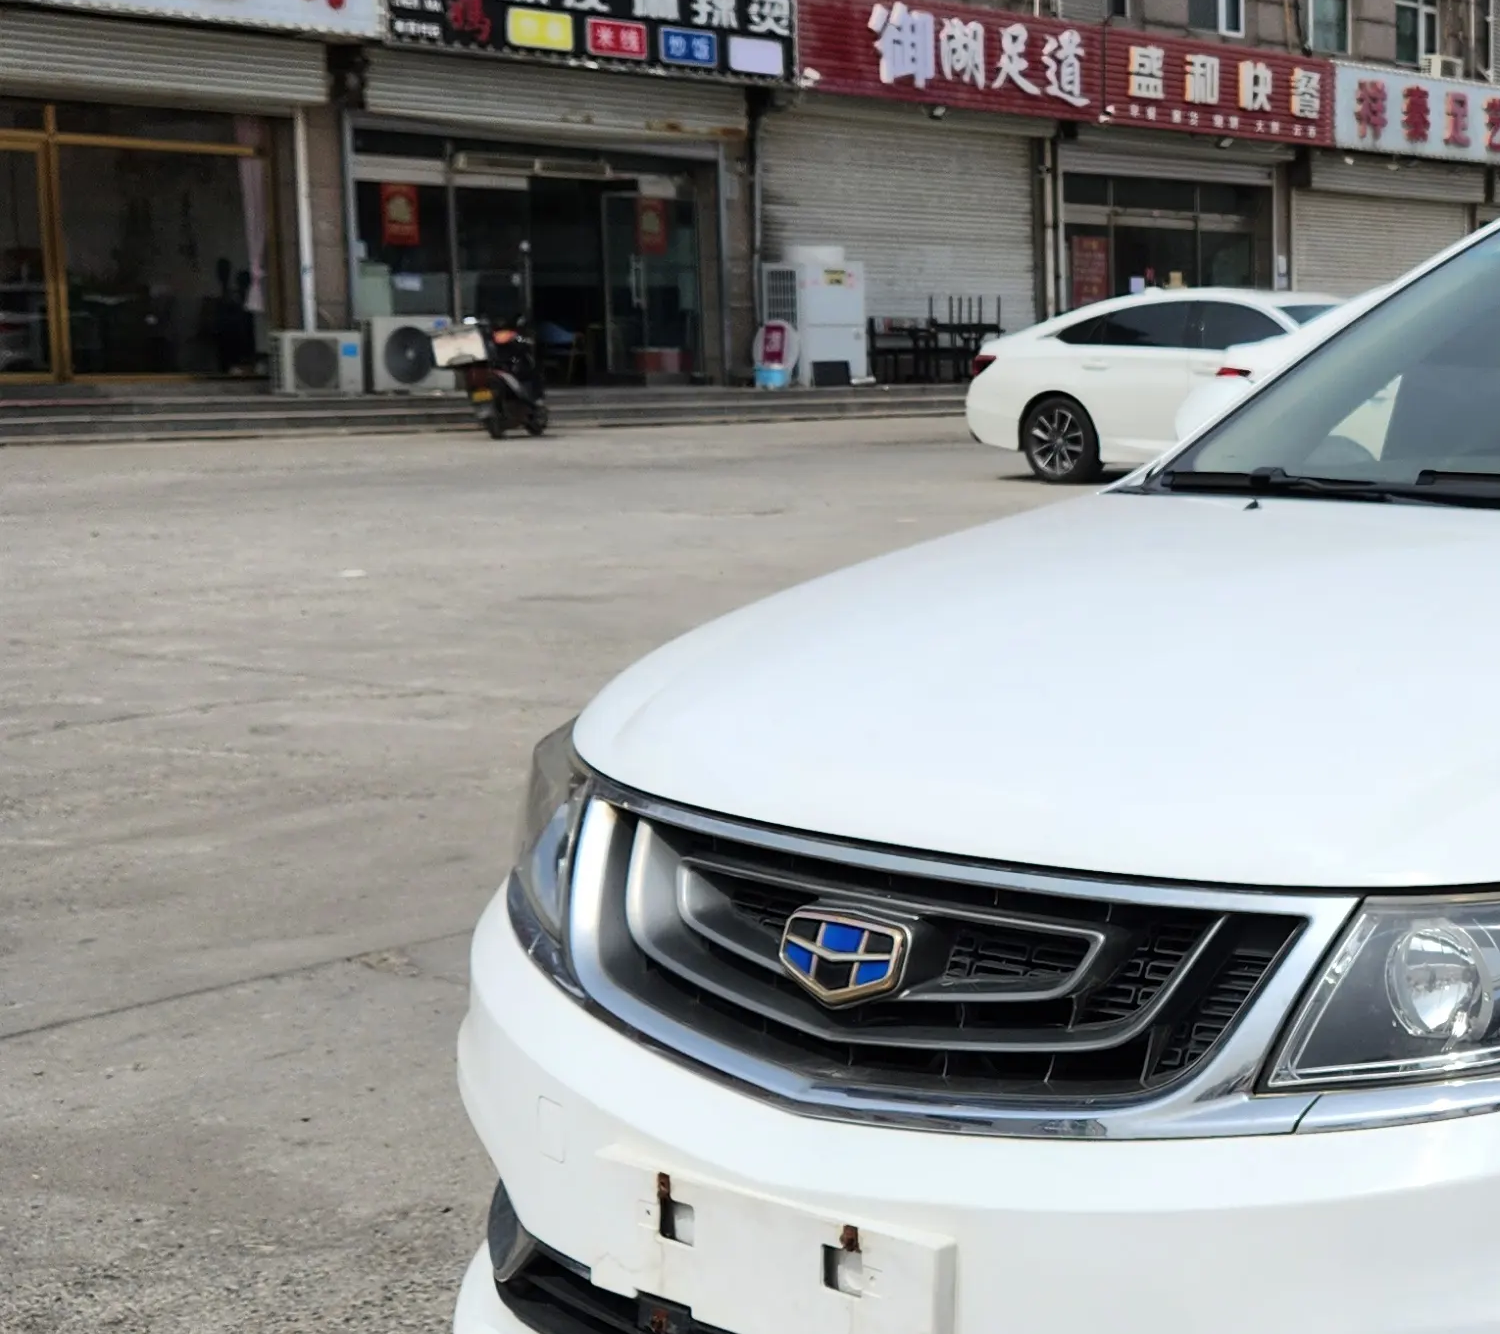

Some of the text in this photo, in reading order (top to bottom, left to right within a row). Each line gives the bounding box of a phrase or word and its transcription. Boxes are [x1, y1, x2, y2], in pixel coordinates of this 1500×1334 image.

[868, 1, 1091, 108] 御湖足道
[1128, 45, 1320, 119] 盛和快餐
